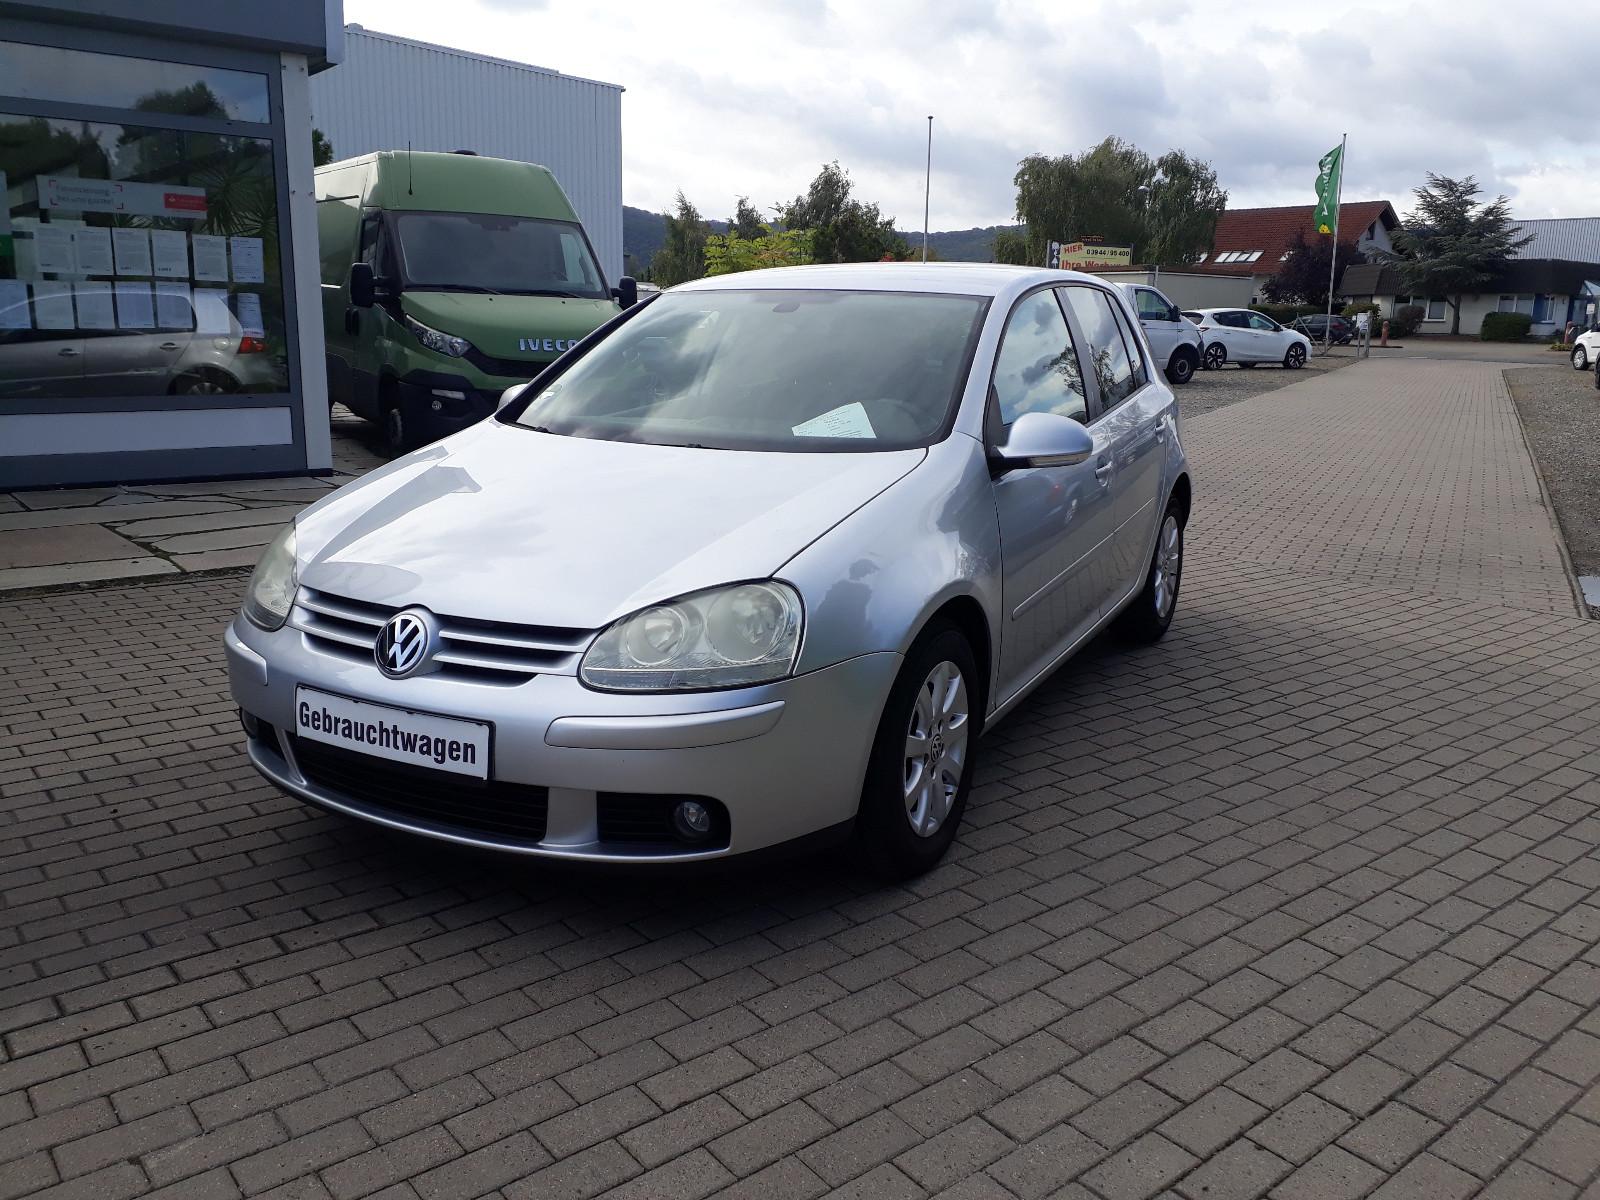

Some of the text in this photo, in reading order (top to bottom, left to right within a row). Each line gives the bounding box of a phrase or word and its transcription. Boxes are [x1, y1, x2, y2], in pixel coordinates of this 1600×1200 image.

[1064, 245, 1083, 254] HIER
[519, 339, 578, 351] IVECO
[299, 701, 477, 764] Gebrauchtwagen
